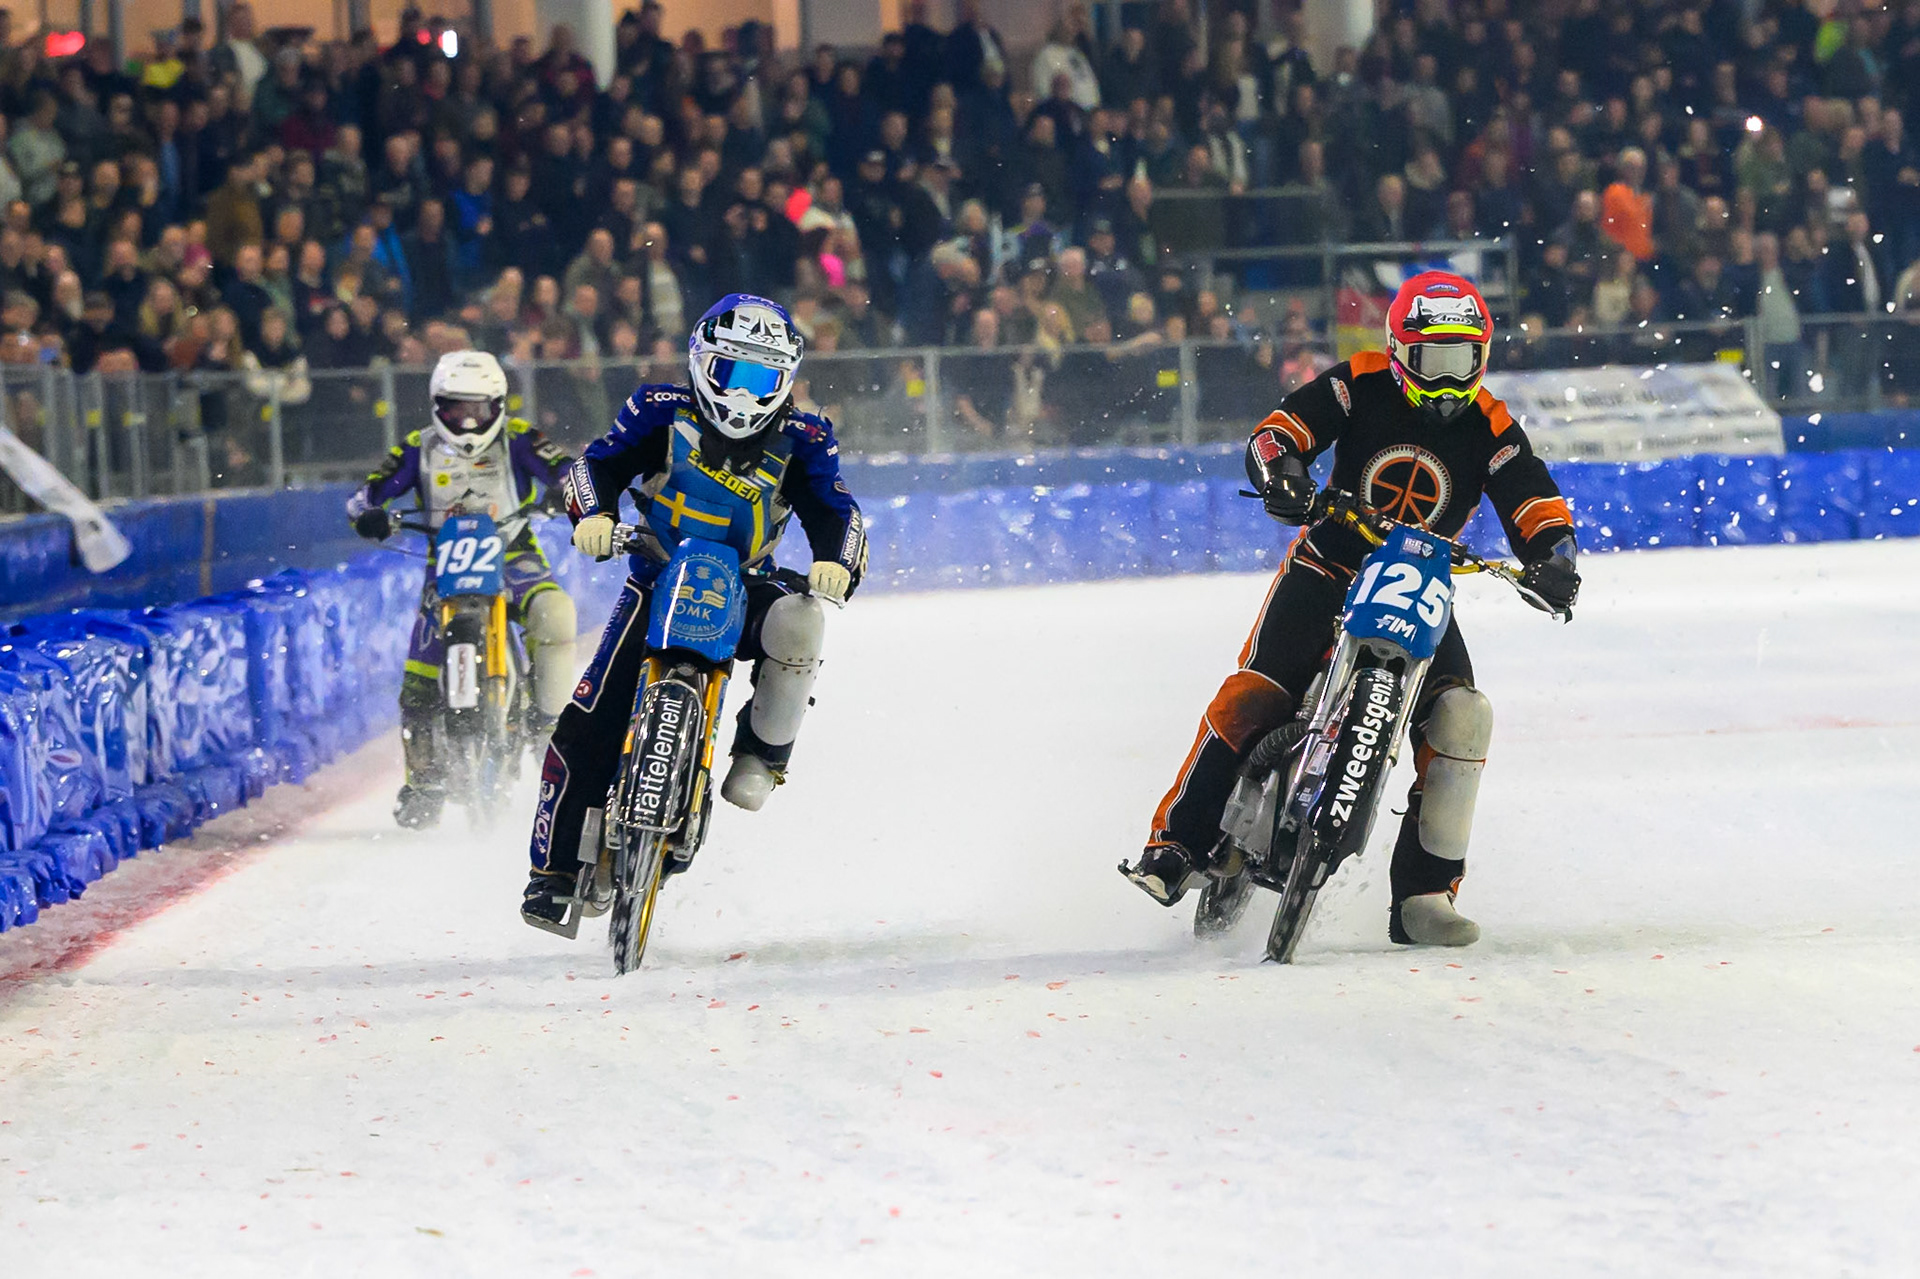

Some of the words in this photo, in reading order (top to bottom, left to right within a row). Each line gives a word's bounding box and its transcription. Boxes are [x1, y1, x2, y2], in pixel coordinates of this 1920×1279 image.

[1440, 314, 1466, 322] Arai
[437, 536, 502, 576] 192
[1353, 562, 1450, 628] 125
[1376, 614, 1415, 638] FIM
